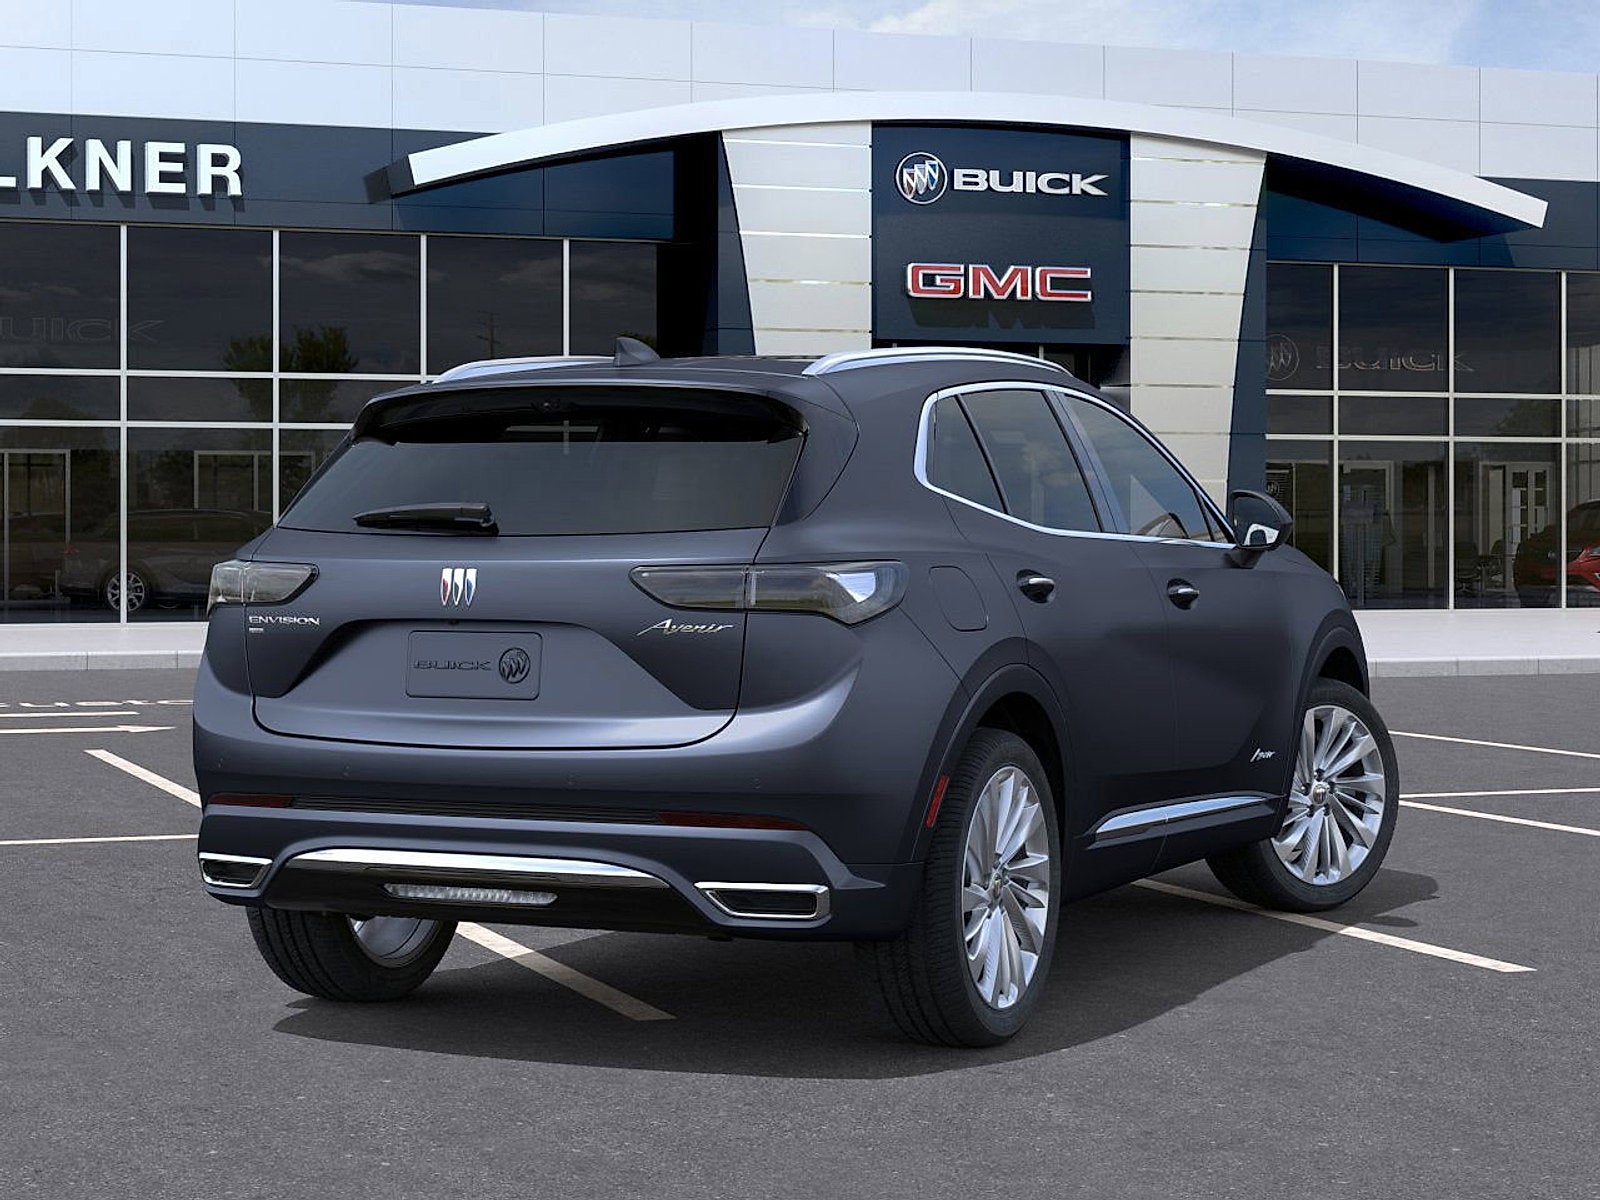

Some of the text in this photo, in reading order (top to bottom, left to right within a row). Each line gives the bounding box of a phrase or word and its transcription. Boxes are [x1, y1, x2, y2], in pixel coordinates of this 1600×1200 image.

[0, 136, 243, 196] KNER
[953, 168, 1110, 197] BUICK
[906, 262, 1092, 302] GMC
[248, 615, 320, 626] ENVISION
[636, 618, 735, 636] Avenir
[412, 659, 492, 671] BUICK
